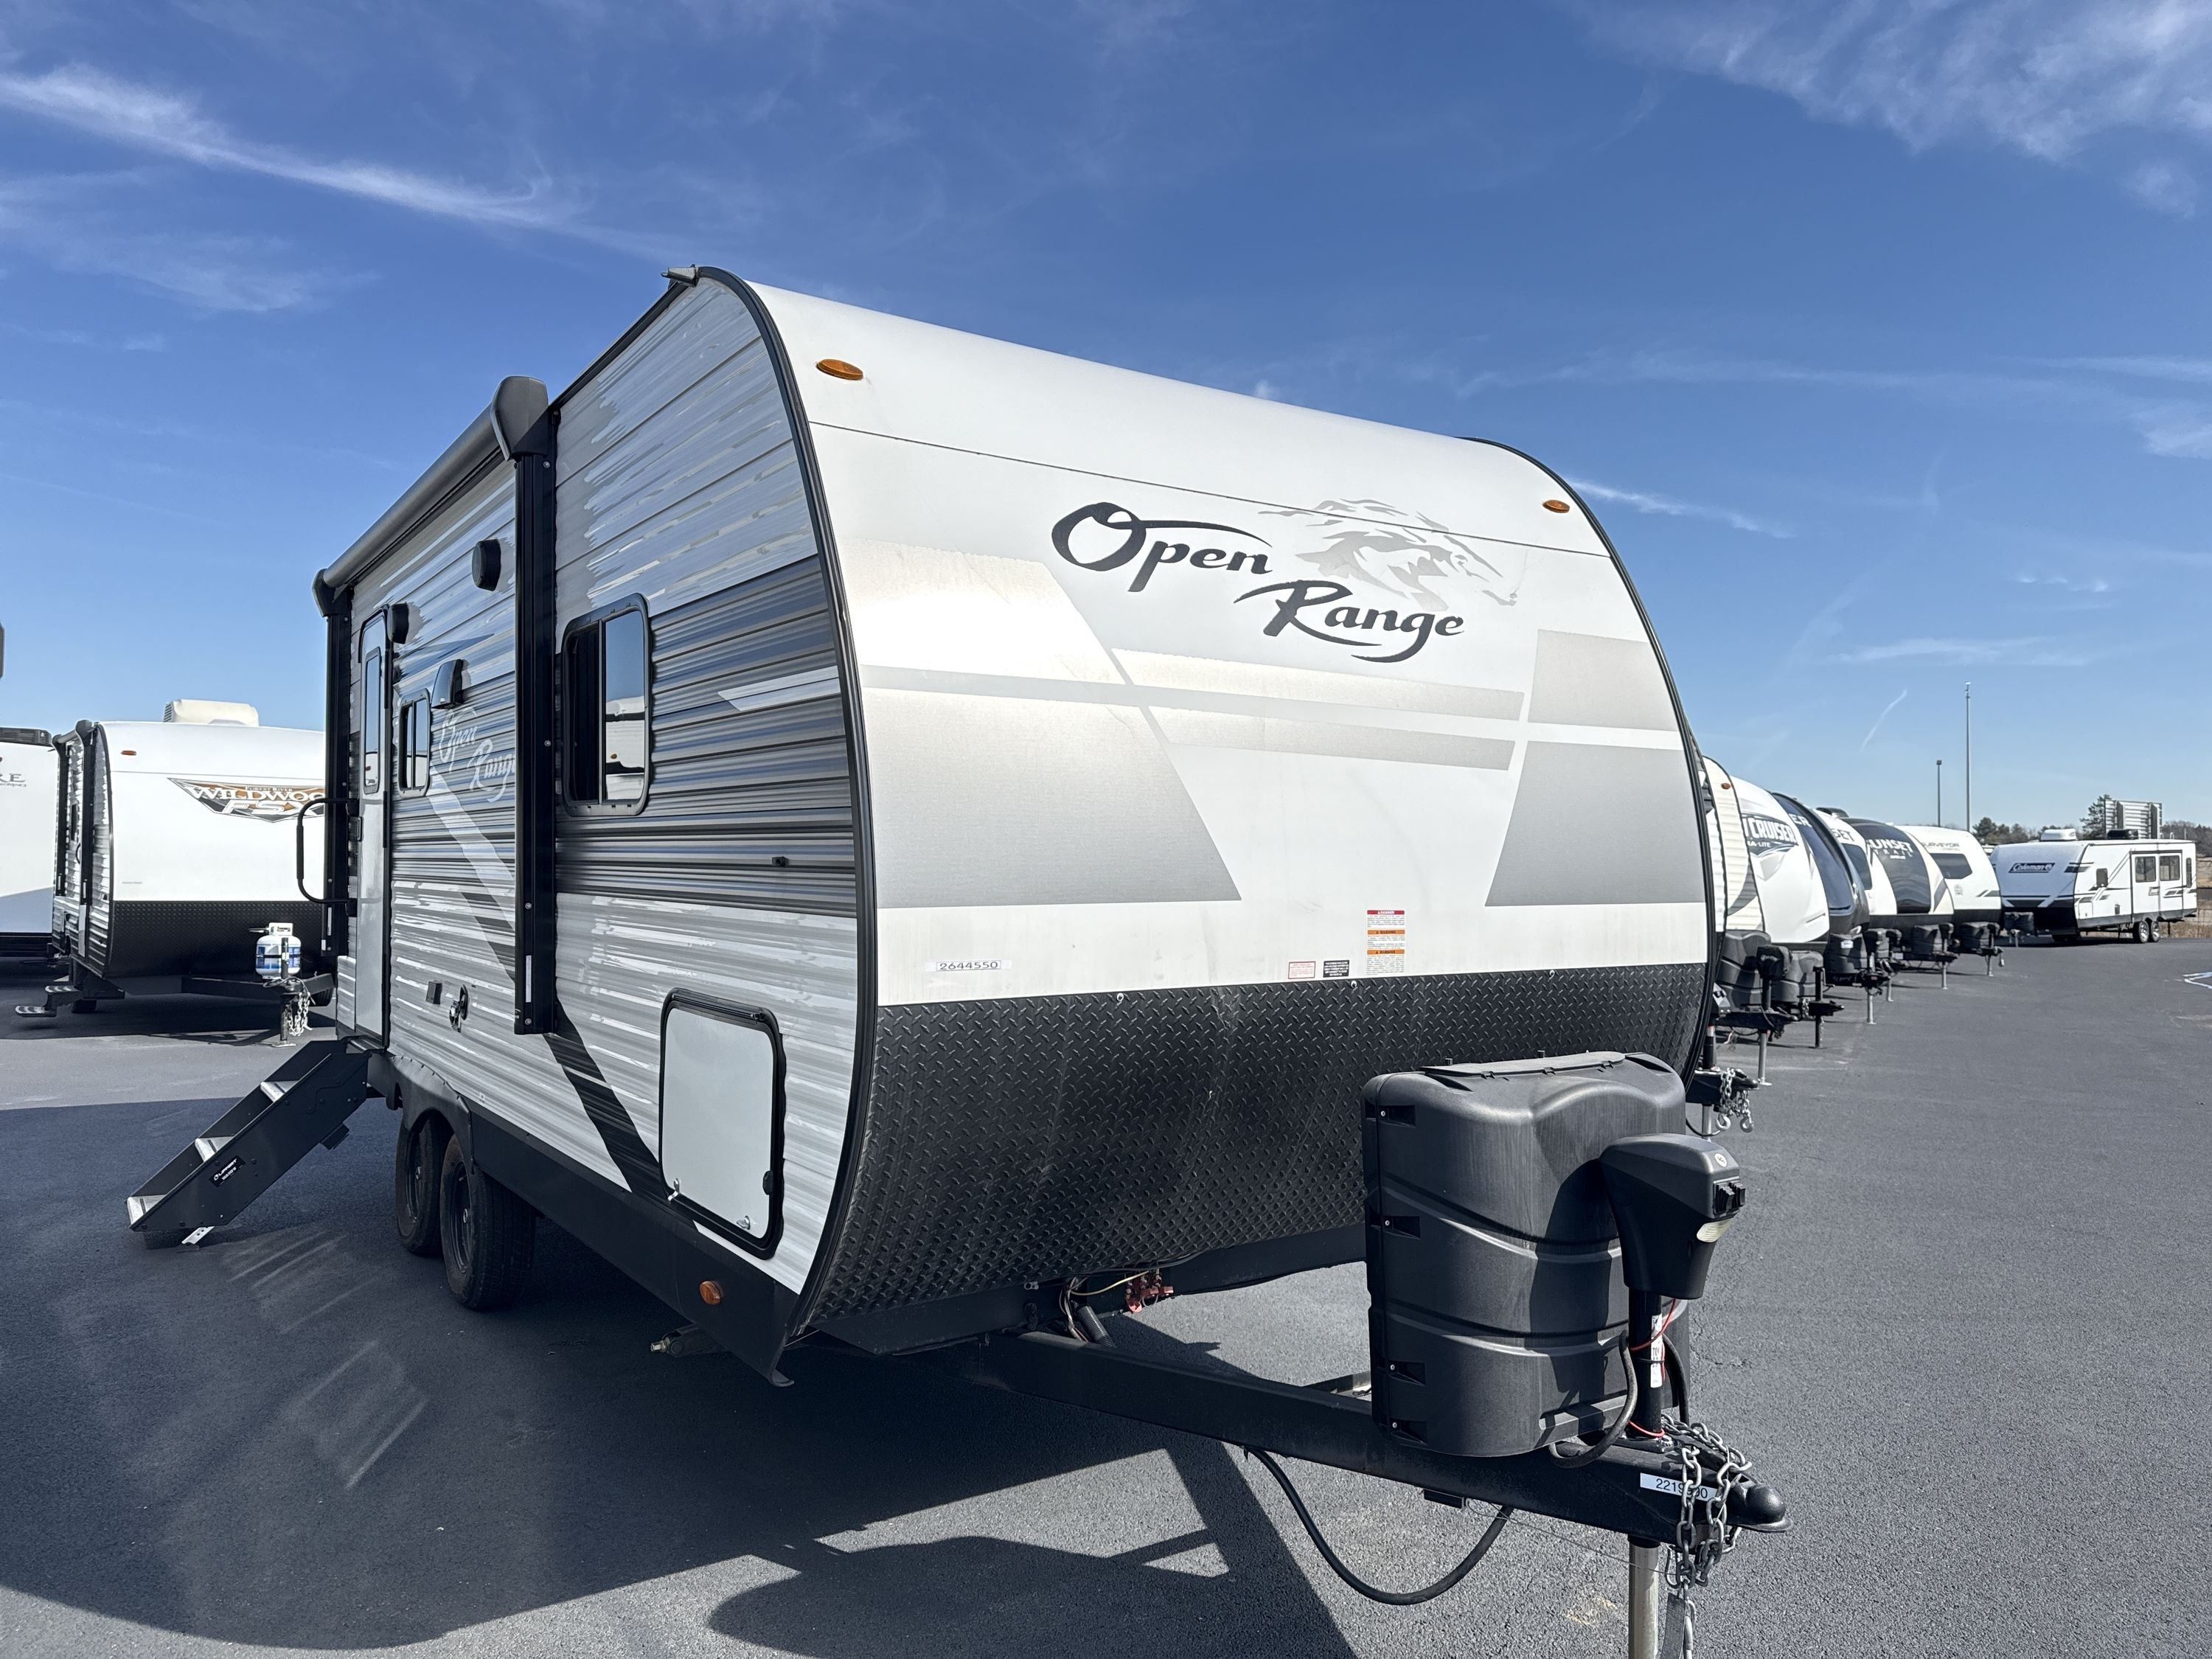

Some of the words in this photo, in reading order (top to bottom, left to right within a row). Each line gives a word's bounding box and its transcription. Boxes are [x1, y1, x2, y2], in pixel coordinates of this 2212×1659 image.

[1051, 501, 1273, 592] Open
[1234, 580, 1465, 664] Range
[439, 706, 479, 774] Open
[1747, 817, 1797, 843] CRUISER
[2013, 863, 2044, 872] Coleman
[939, 961, 998, 970] 2644550
